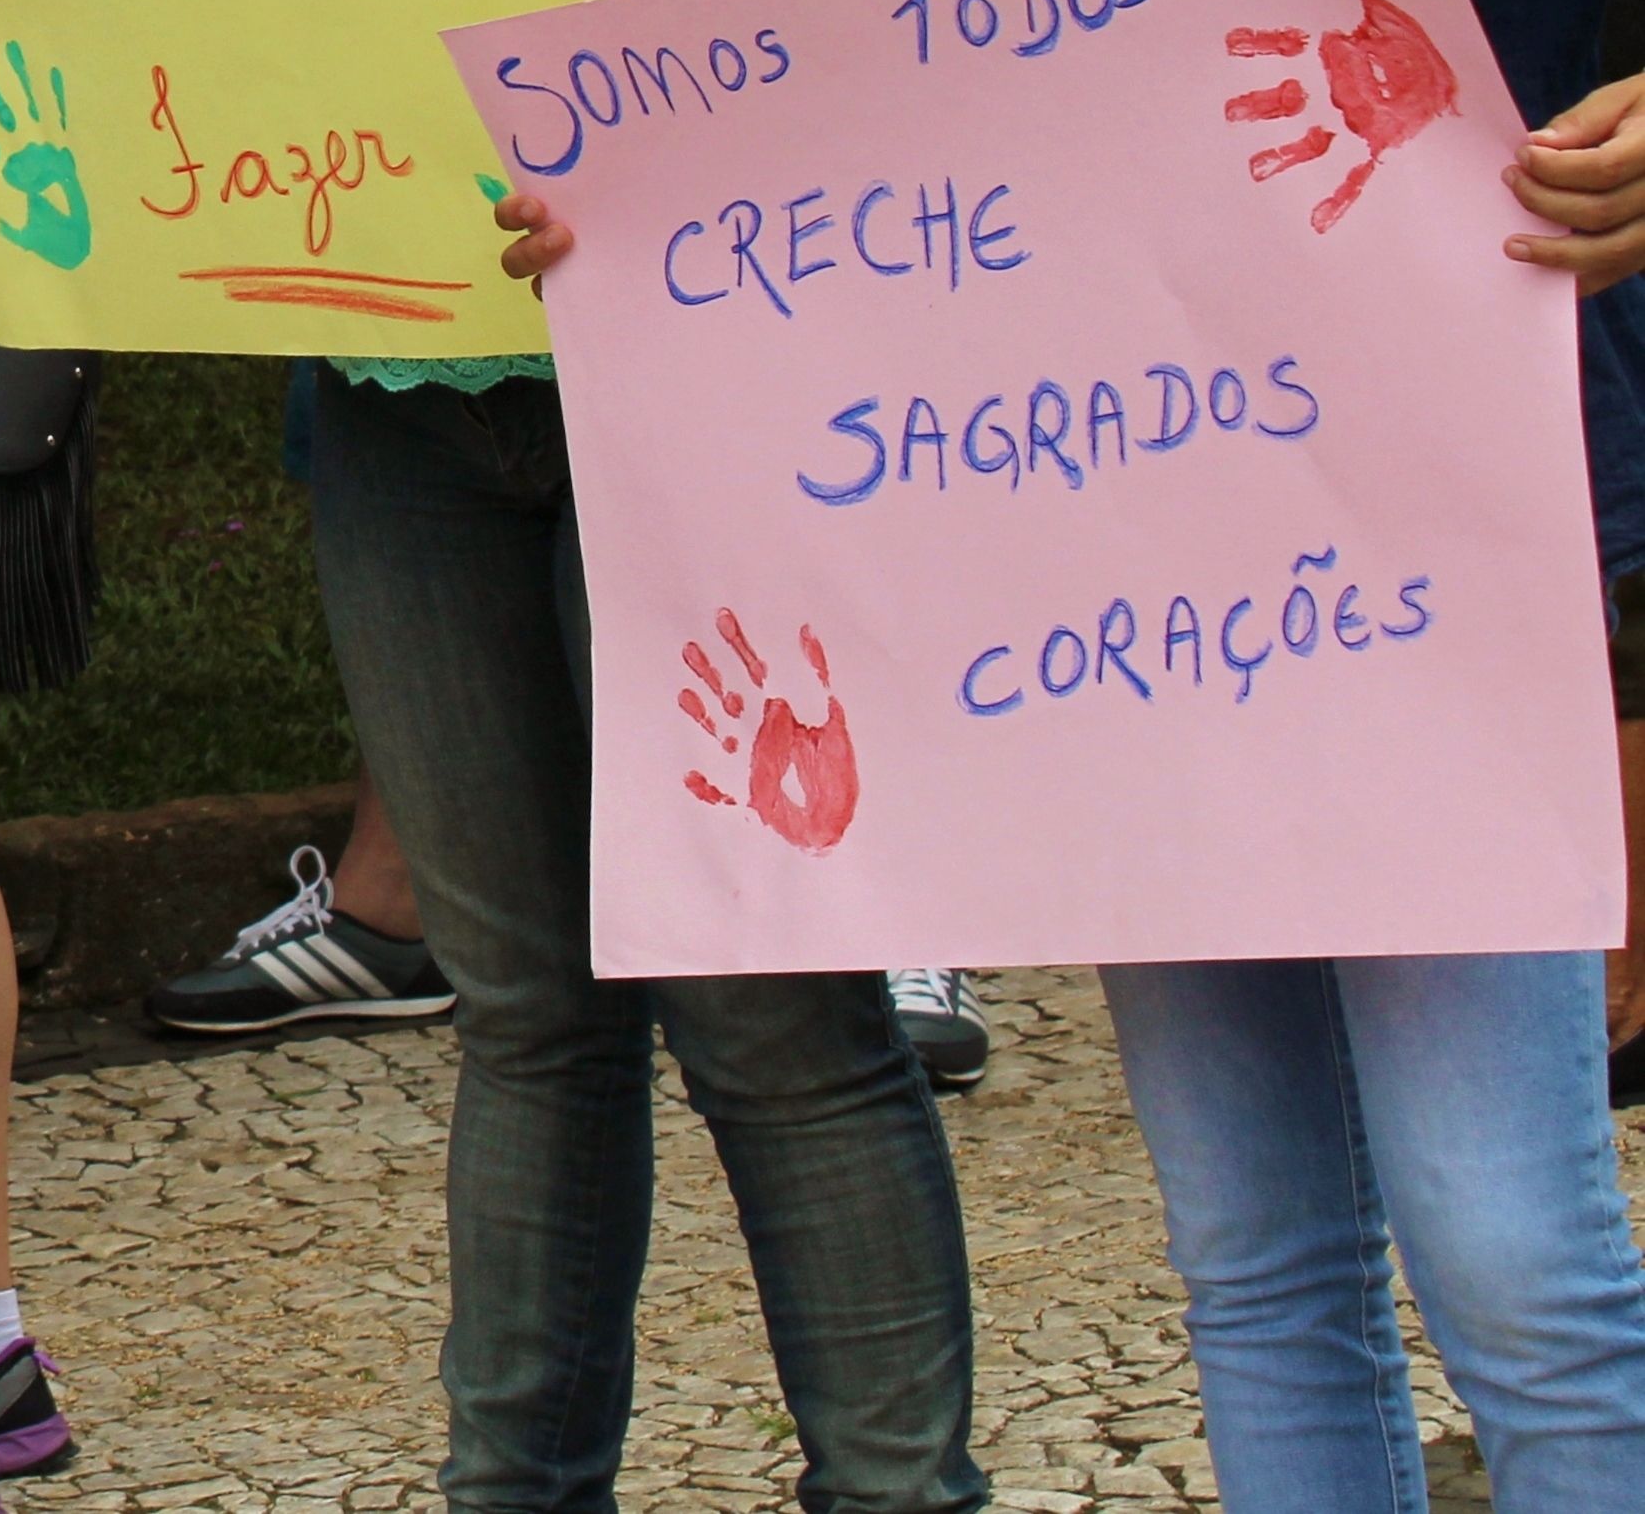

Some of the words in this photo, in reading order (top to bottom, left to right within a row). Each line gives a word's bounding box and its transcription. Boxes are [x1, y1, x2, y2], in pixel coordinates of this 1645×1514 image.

[496, 29, 791, 177] SOMOS
[665, 177, 1031, 319] CRECHE
[797, 355, 1319, 507] SAGRADOS
[956, 545, 1432, 717] CORAÇÕES
